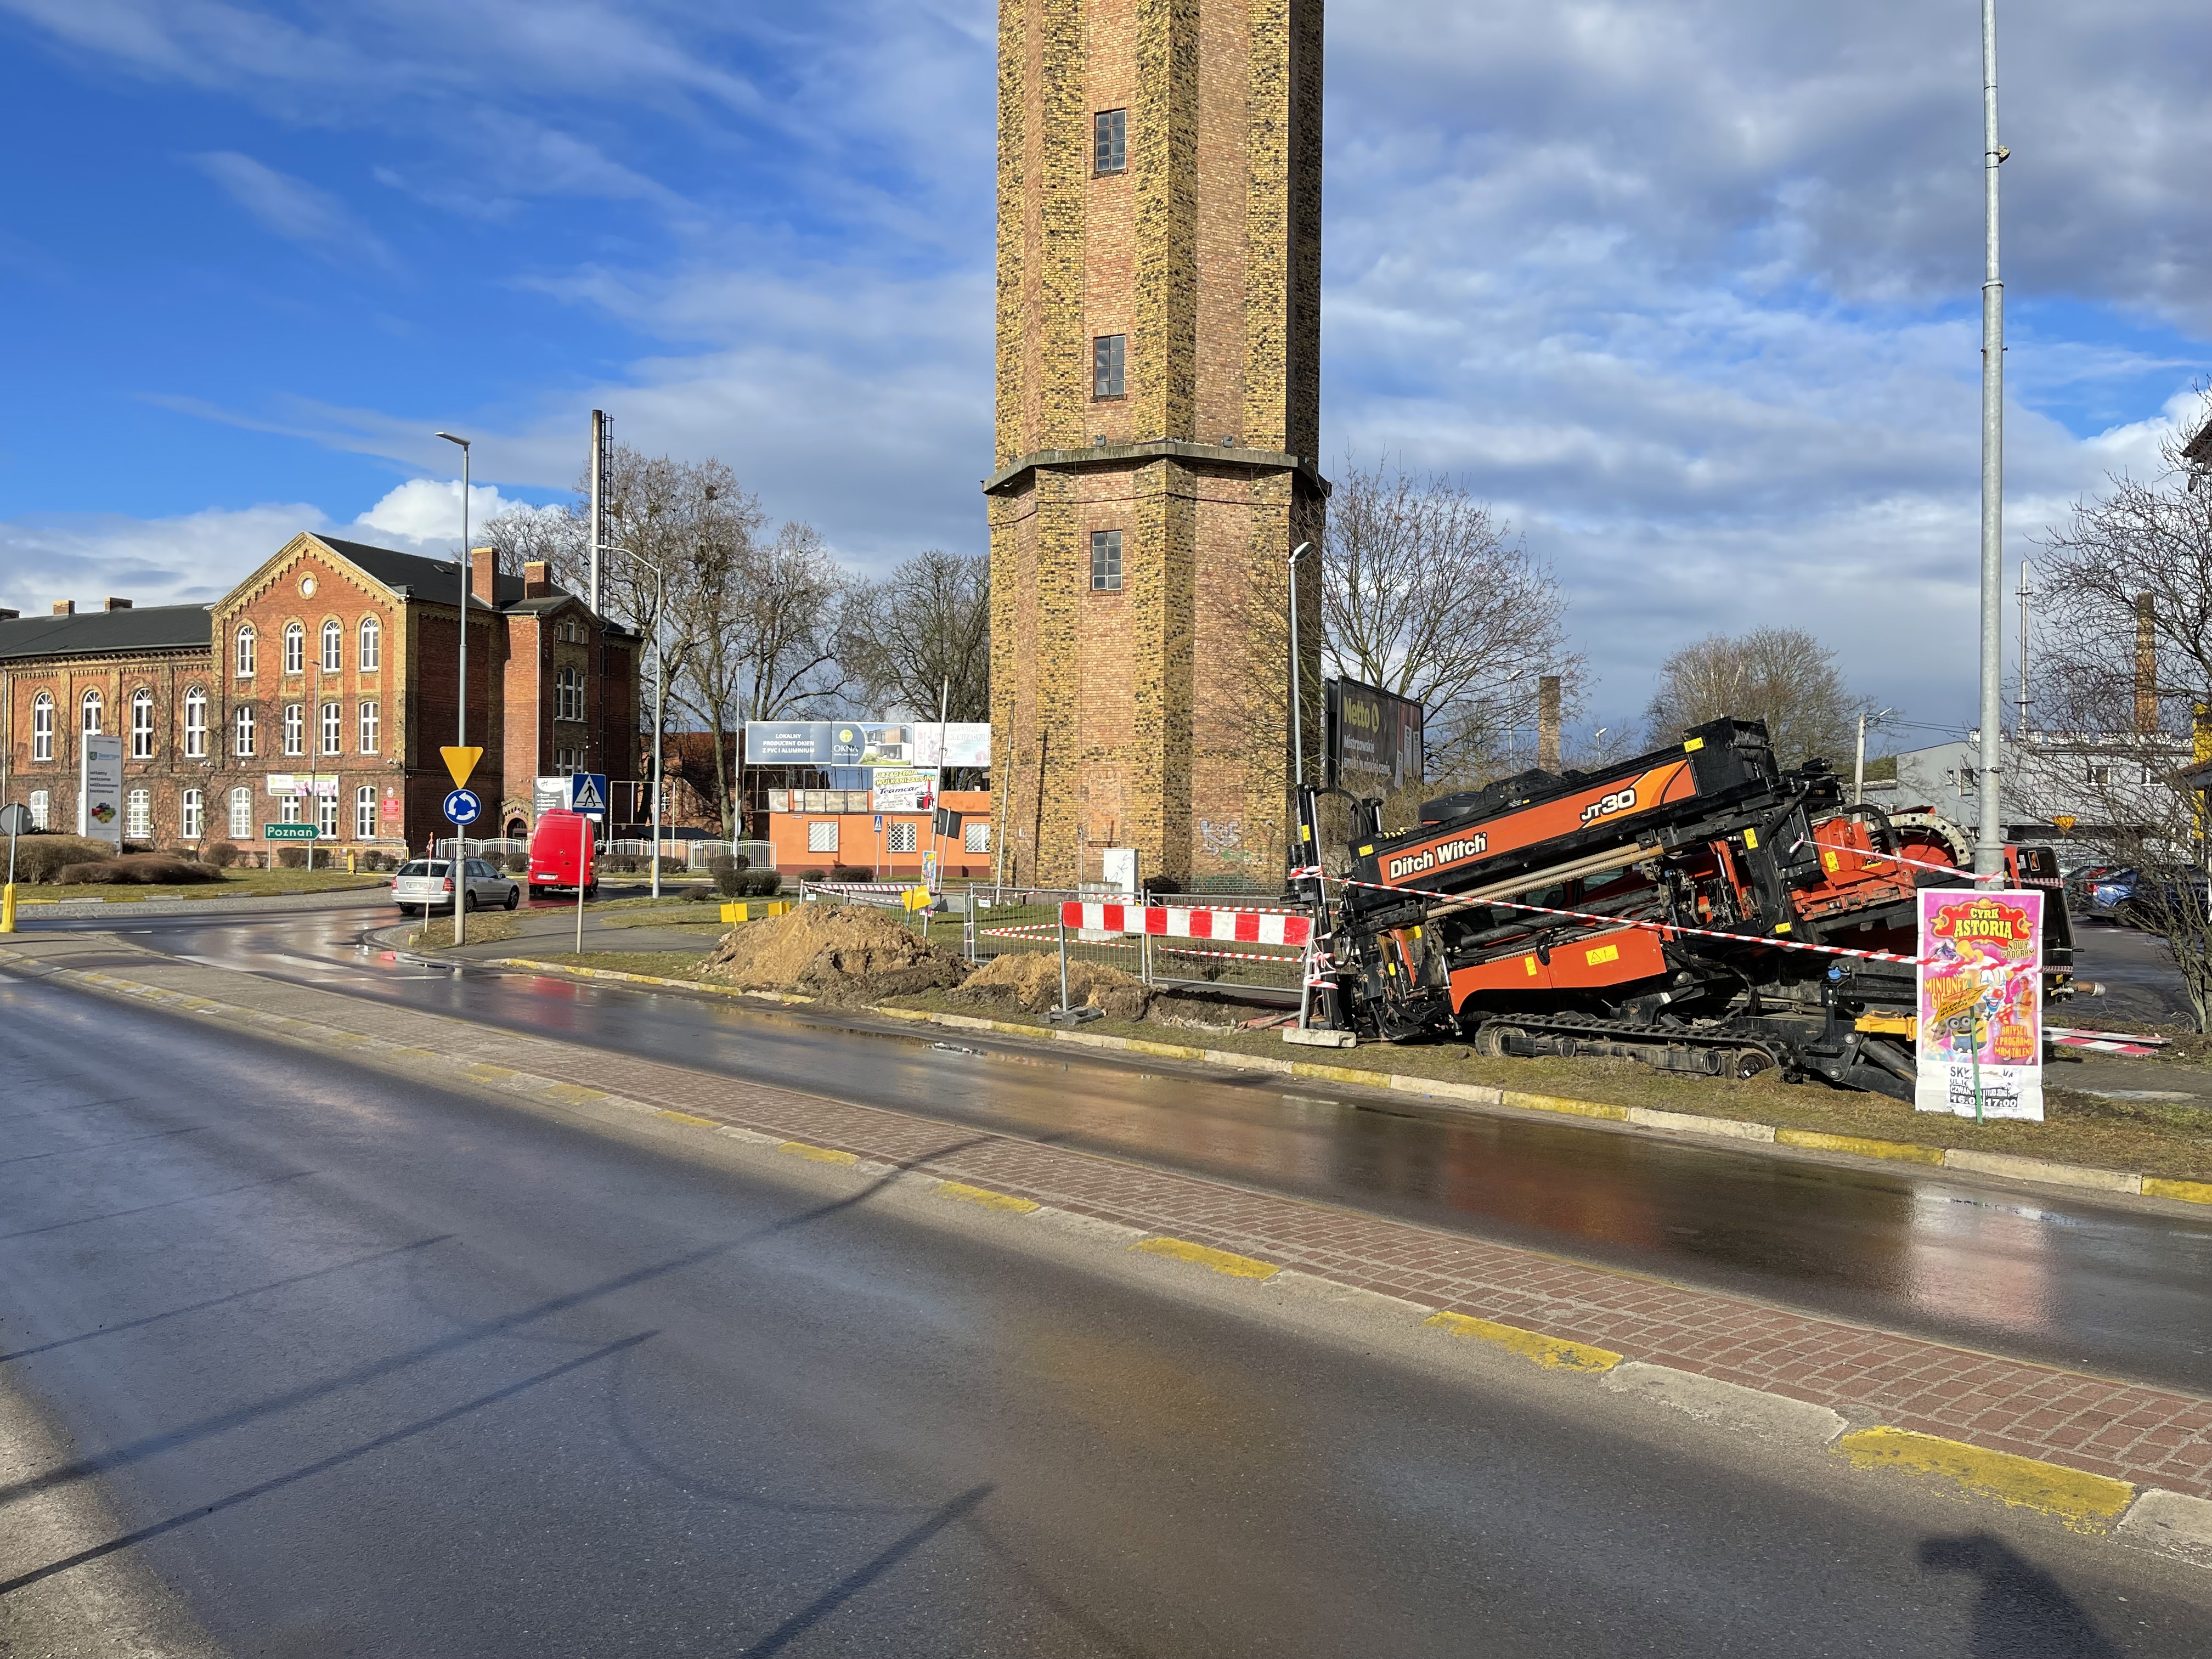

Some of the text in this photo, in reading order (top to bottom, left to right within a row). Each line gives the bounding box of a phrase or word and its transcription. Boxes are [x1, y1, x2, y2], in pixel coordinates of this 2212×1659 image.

[1344, 696, 1370, 729] Netto
[833, 744, 859, 753] OKNA
[1344, 733, 1375, 754] Mistrzowskie
[876, 775, 935, 785] WULKANIZACYJNE
[1581, 789, 1635, 820] JT30
[267, 827, 313, 837] Poznań
[1390, 833, 1487, 879] Ditch Witch
[1970, 907, 2000, 919] CYRK
[1954, 919, 2013, 939] ASTORIA
[2008, 940, 2029, 951] NOWY
[2002, 949, 2035, 958] PROGRAM
[2000, 1037, 2033, 1046] PROGRAMU
[1994, 1047, 2033, 1058] MAM TALENT
[1951, 1095, 2017, 1107] 16.0 17:00
